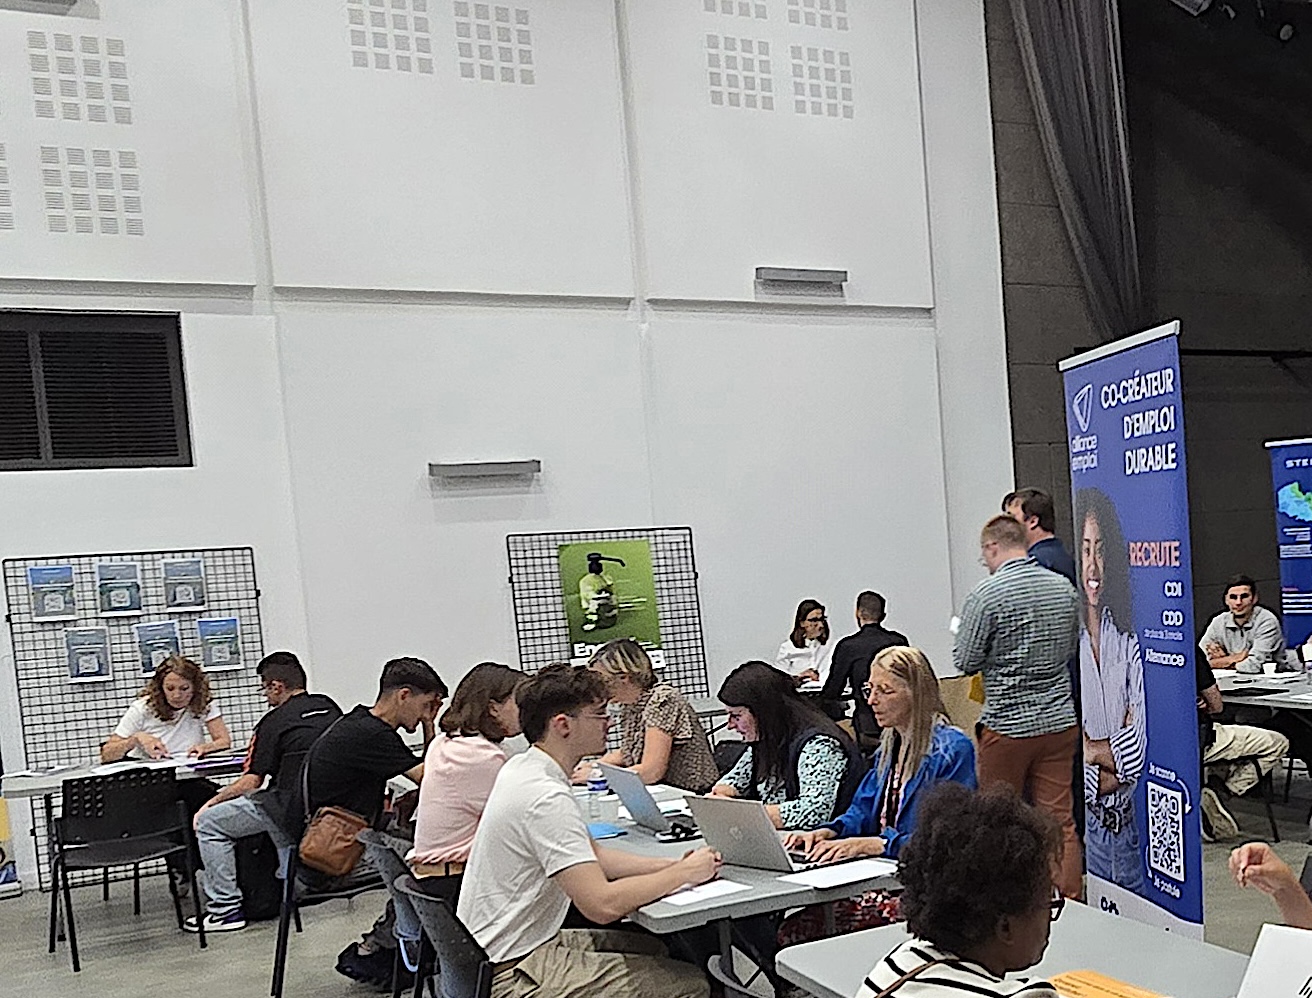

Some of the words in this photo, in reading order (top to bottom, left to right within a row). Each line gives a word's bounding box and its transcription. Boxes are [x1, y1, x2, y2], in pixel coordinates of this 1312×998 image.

[1101, 369, 1174, 409] CO-CRÉATEUR
[1123, 405, 1176, 440] D'EMPLOI
[1125, 442, 1177, 476] DURABLE
[1129, 540, 1180, 567] RECRUTE
